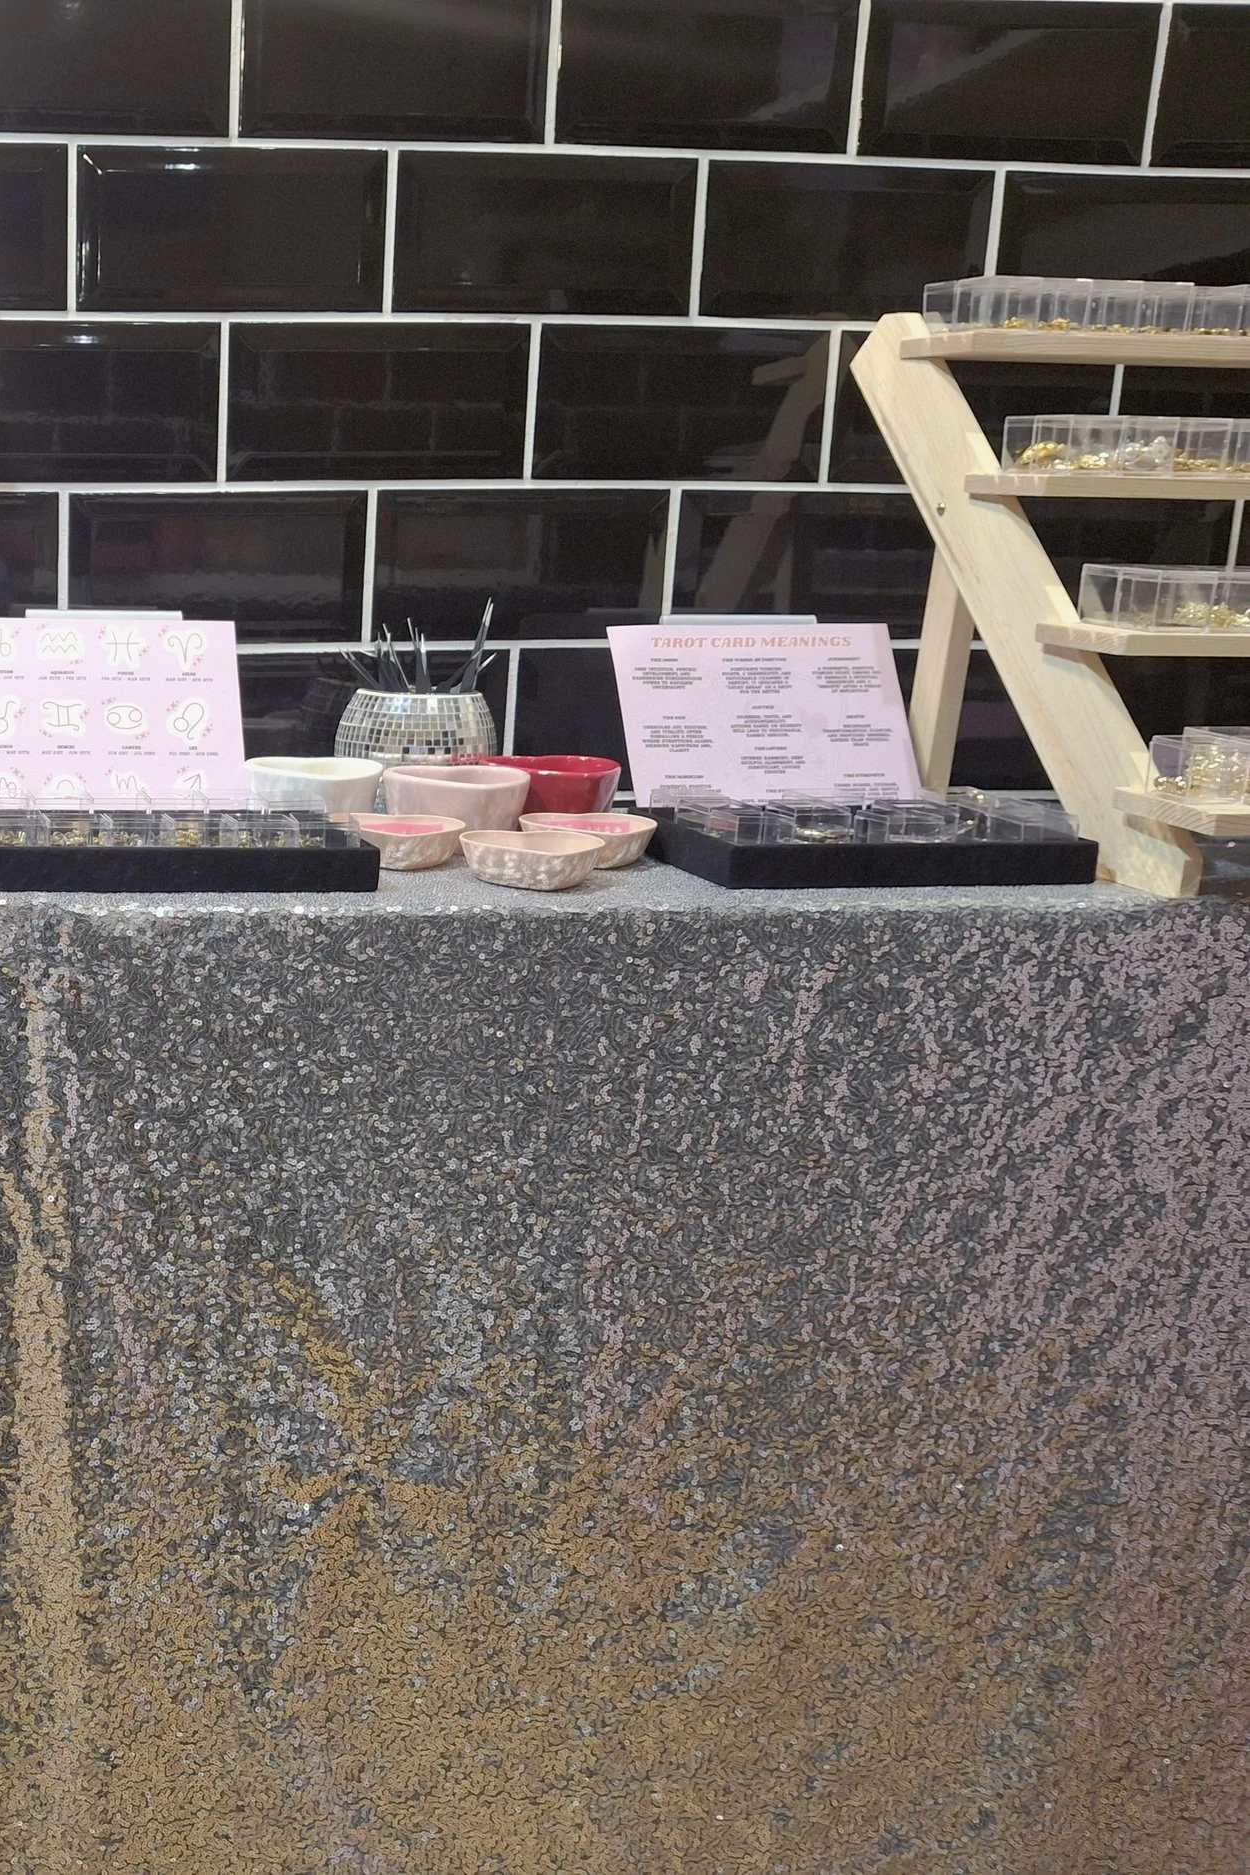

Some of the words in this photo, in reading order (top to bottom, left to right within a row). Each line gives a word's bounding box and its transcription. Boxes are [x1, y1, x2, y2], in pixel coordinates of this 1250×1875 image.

[650, 636, 708, 649] TAROT
[711, 636, 756, 649] CARD
[760, 635, 853, 648] MEANINGS
